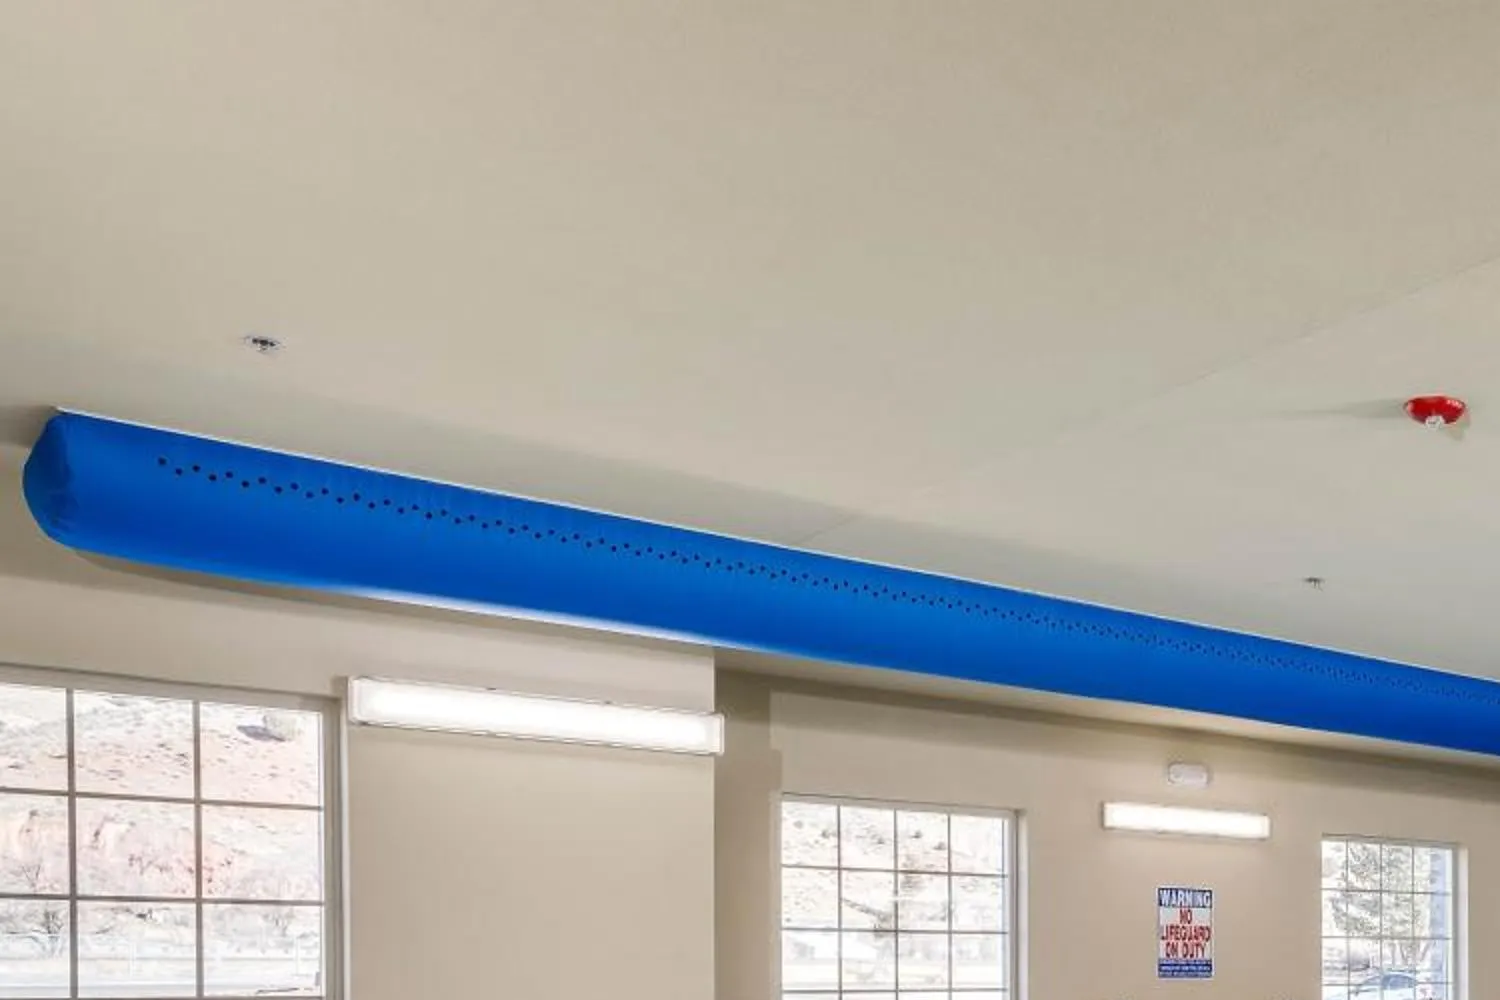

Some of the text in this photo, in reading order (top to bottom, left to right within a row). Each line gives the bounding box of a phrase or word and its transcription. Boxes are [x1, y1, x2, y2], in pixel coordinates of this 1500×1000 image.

[1160, 889, 1211, 907] WARNING
[1179, 909, 1193, 925] NO
[1161, 925, 1211, 942] LIFEGUARD
[1165, 942, 1206, 958] ON DUTY
